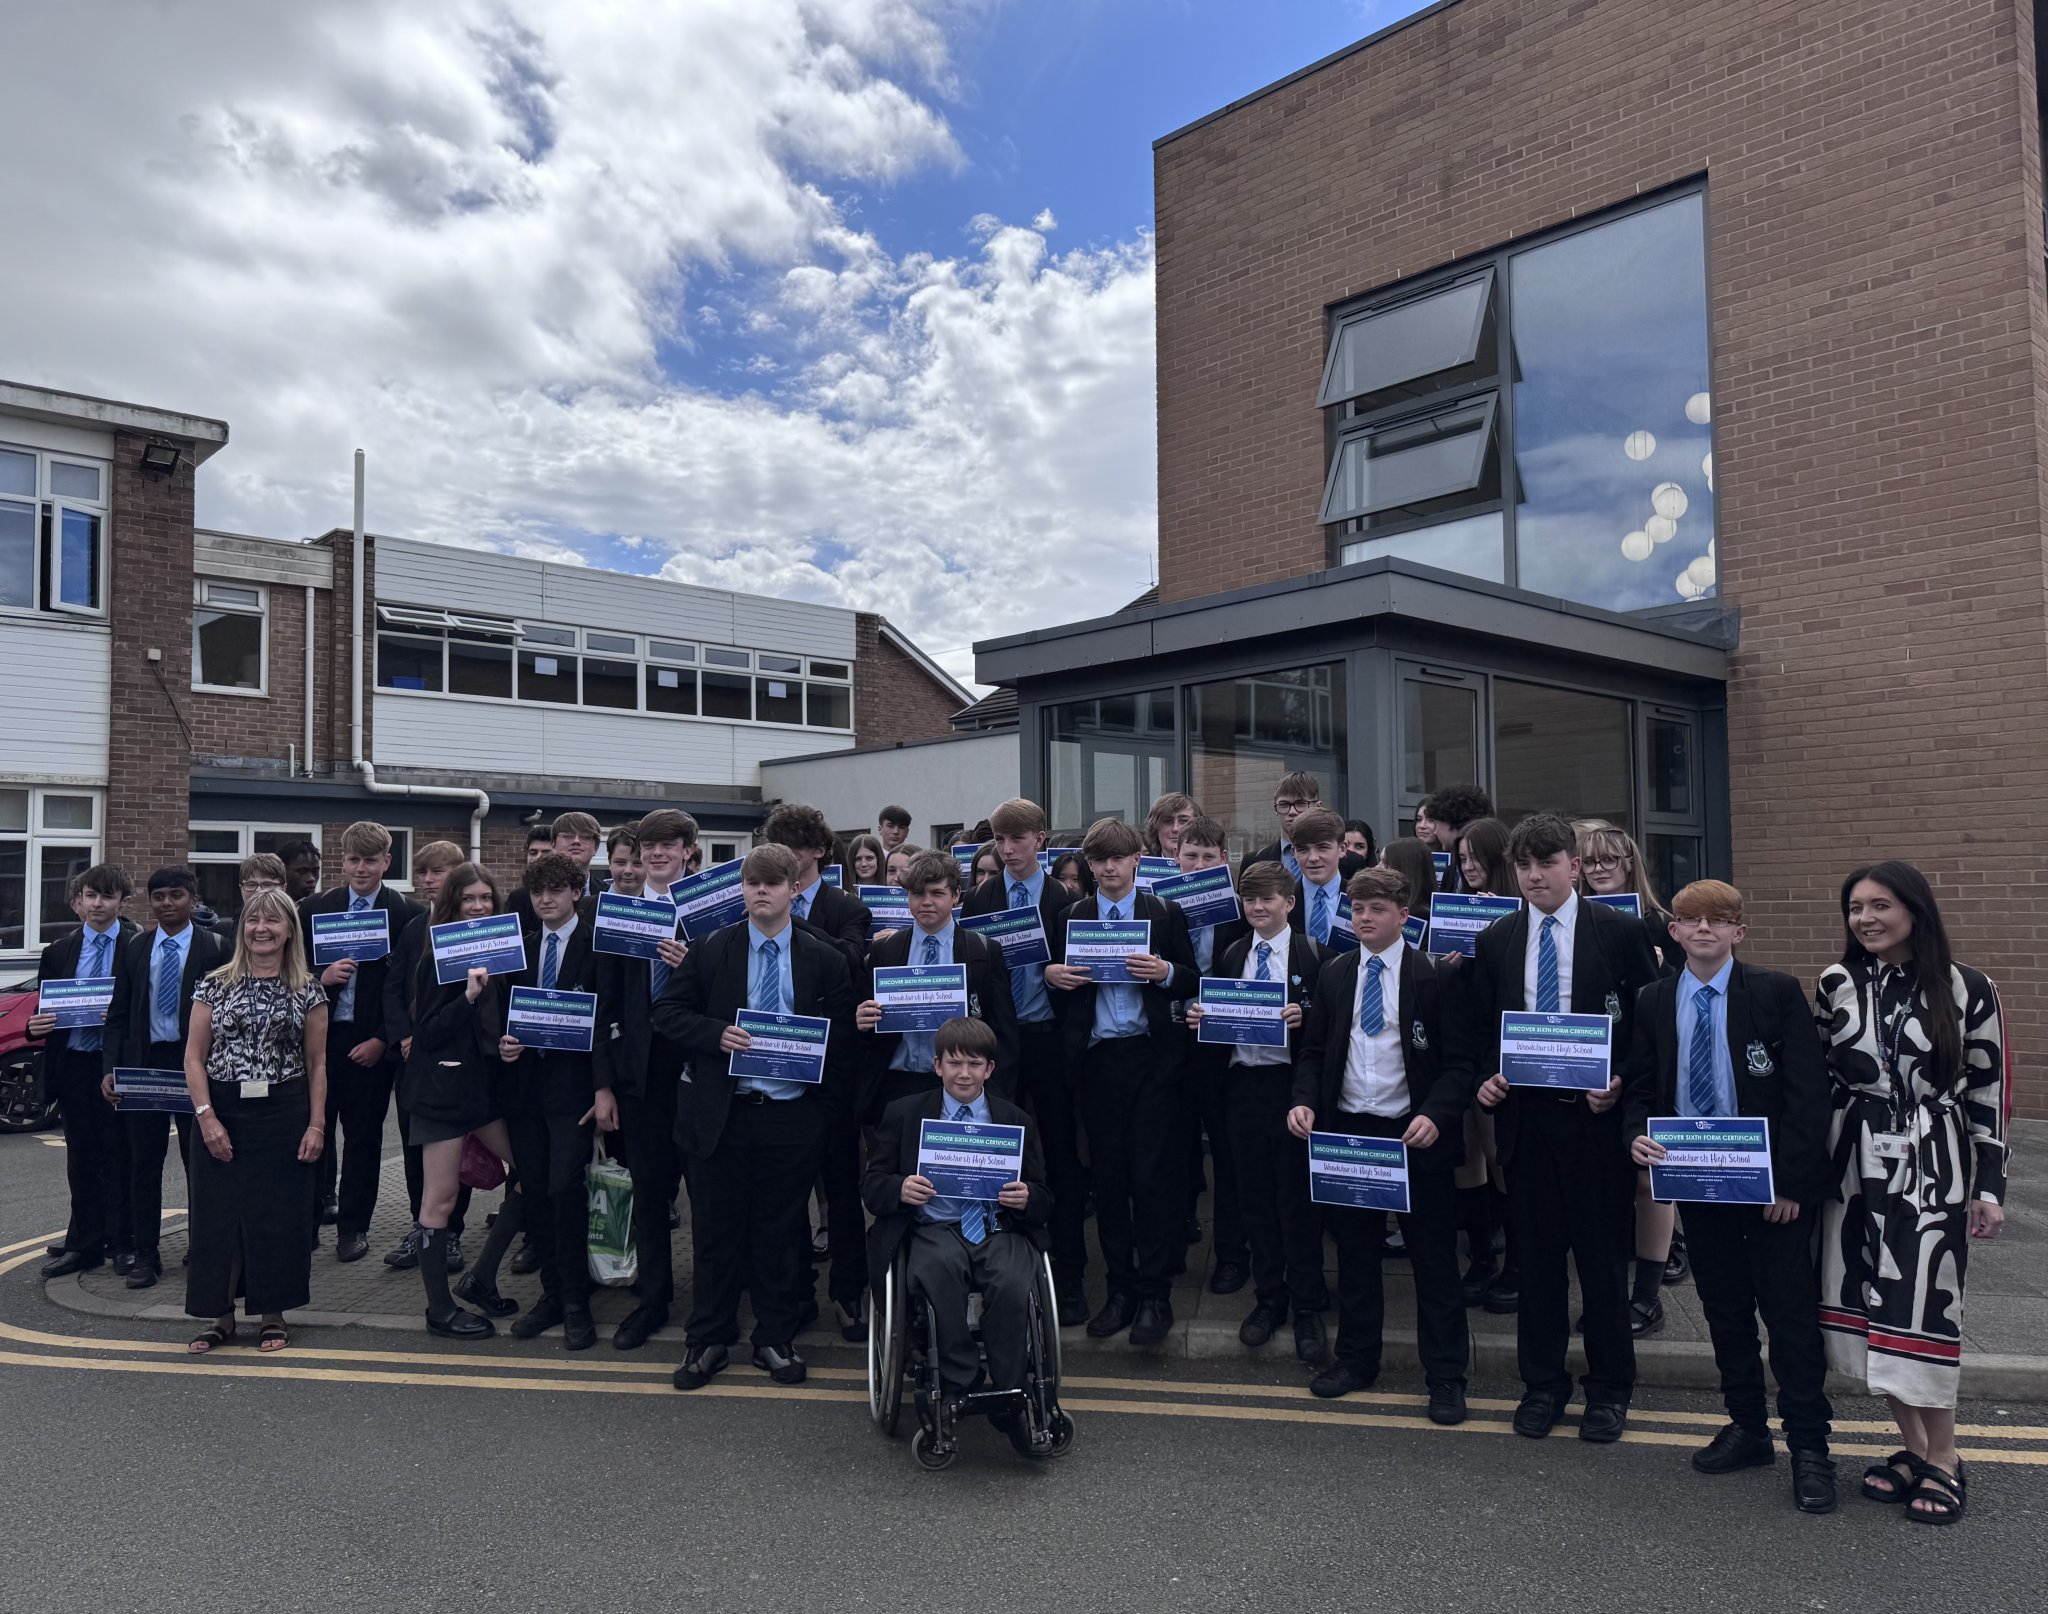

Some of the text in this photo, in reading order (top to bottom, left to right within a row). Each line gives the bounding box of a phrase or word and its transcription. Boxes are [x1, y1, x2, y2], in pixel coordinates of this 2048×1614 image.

[1078, 946, 1109, 954] Woodchurch
[1109, 946, 1120, 956] High
[888, 991, 953, 1003] Woodchurch High School
[564, 1002, 590, 1010] CERTIFICATE
[1211, 1005, 1273, 1018] Woodchurch High School
[520, 1011, 581, 1025] Woodchurch High School
[794, 1028, 822, 1036] CERTIFICATE
[781, 1041, 794, 1052] High
[795, 1042, 812, 1052] School
[1516, 1041, 1593, 1056] Woodchurch High School
[927, 1134, 953, 1142] DISCOVER
[985, 1139, 1016, 1147] CERTIFICATE
[1703, 1134, 1721, 1142] FORM
[1314, 1146, 1338, 1154] DISCOVER
[1369, 1151, 1400, 1159] CERTIFICATE
[934, 1152, 1006, 1168] Woodchurch High School
[1666, 1152, 1751, 1167] Woodchurch High School
[1323, 1162, 1392, 1178] Woodchurch High School
